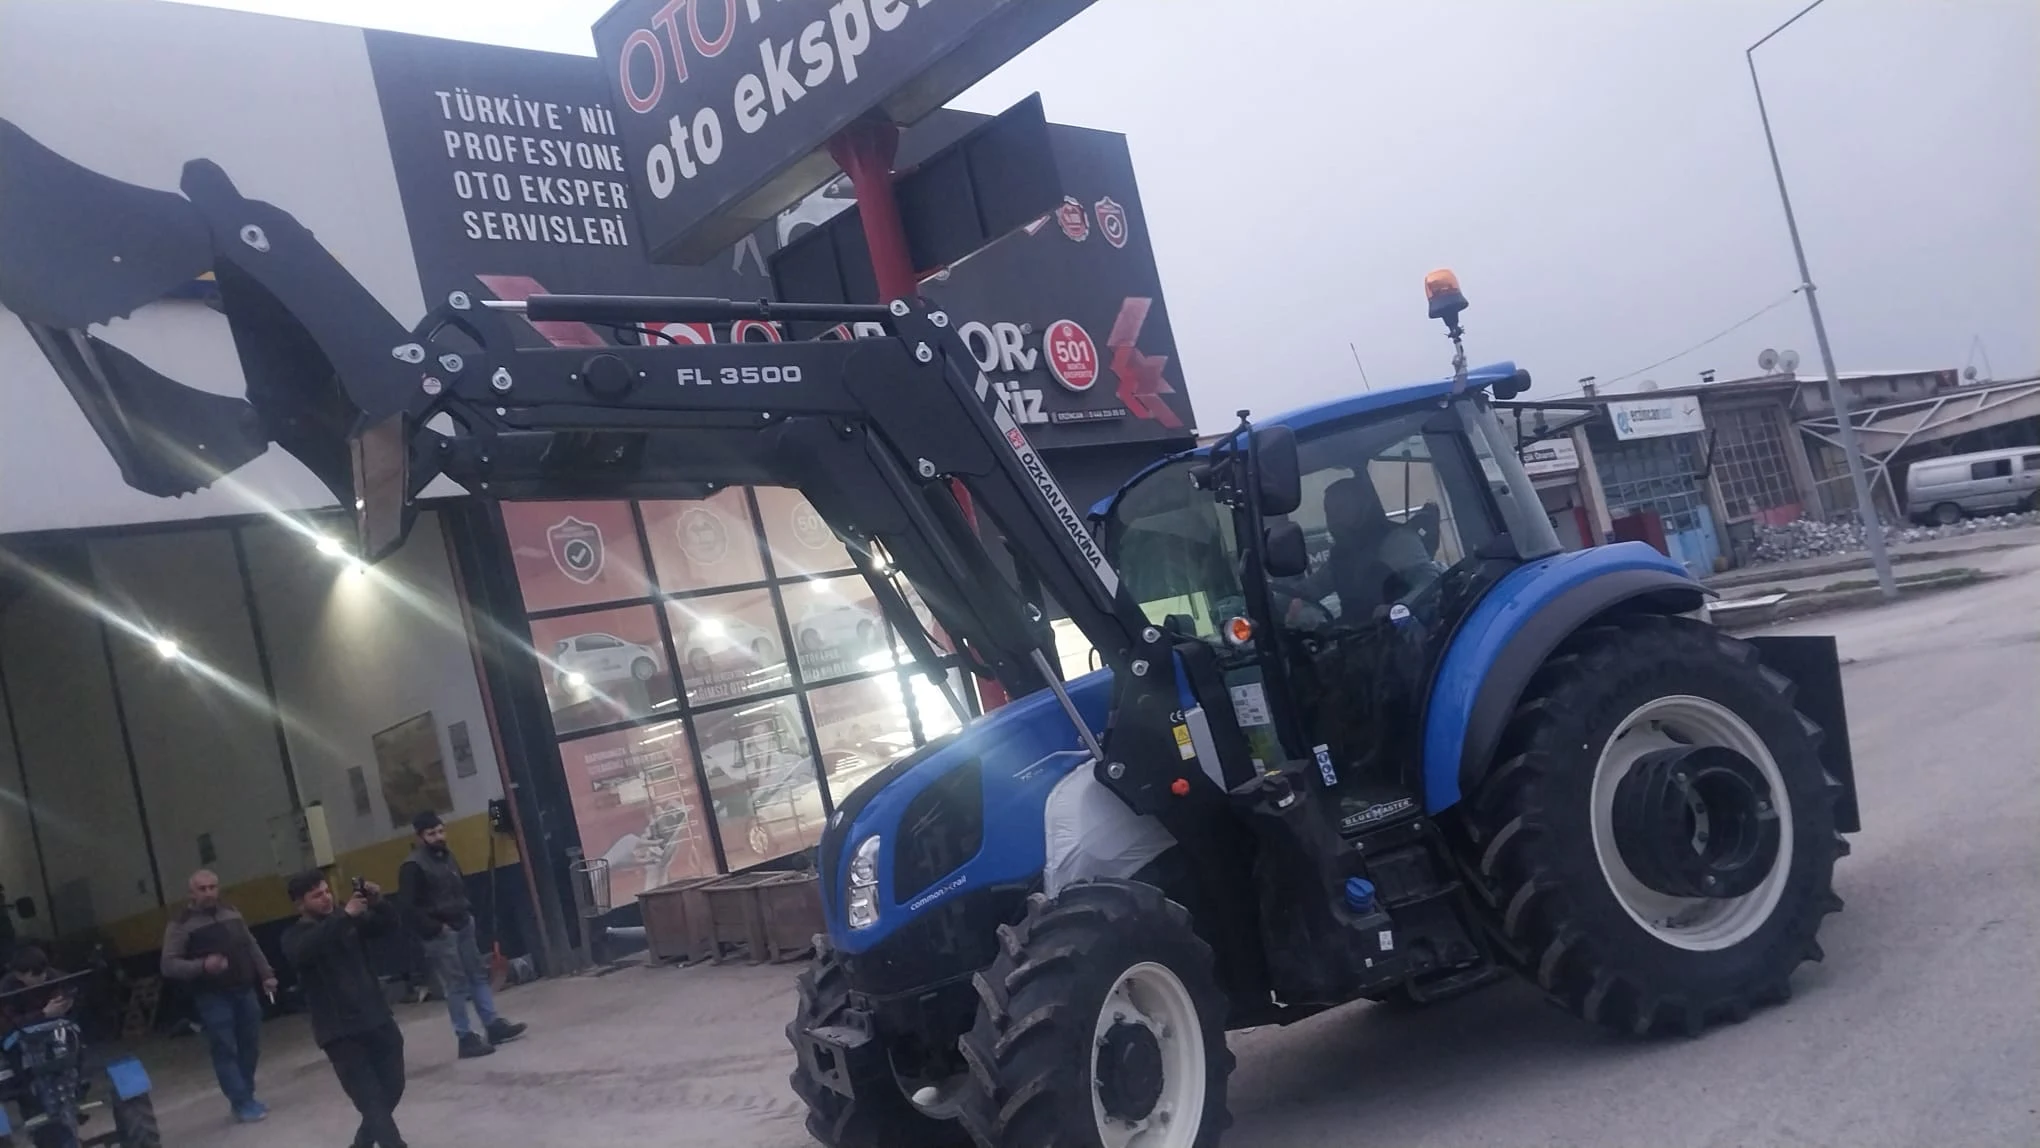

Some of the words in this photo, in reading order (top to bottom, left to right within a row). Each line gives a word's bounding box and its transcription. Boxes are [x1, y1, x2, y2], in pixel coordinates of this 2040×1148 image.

[620, 0, 782, 114] OTO
[647, 107, 723, 199] oto
[734, 0, 933, 133] ekspe
[453, 170, 511, 201] OTO
[1055, 340, 1091, 362] 501
[677, 368, 712, 385] FL
[719, 366, 802, 385] 3500
[1058, 507, 1102, 569] MAKİNA
[910, 887, 944, 911] common
